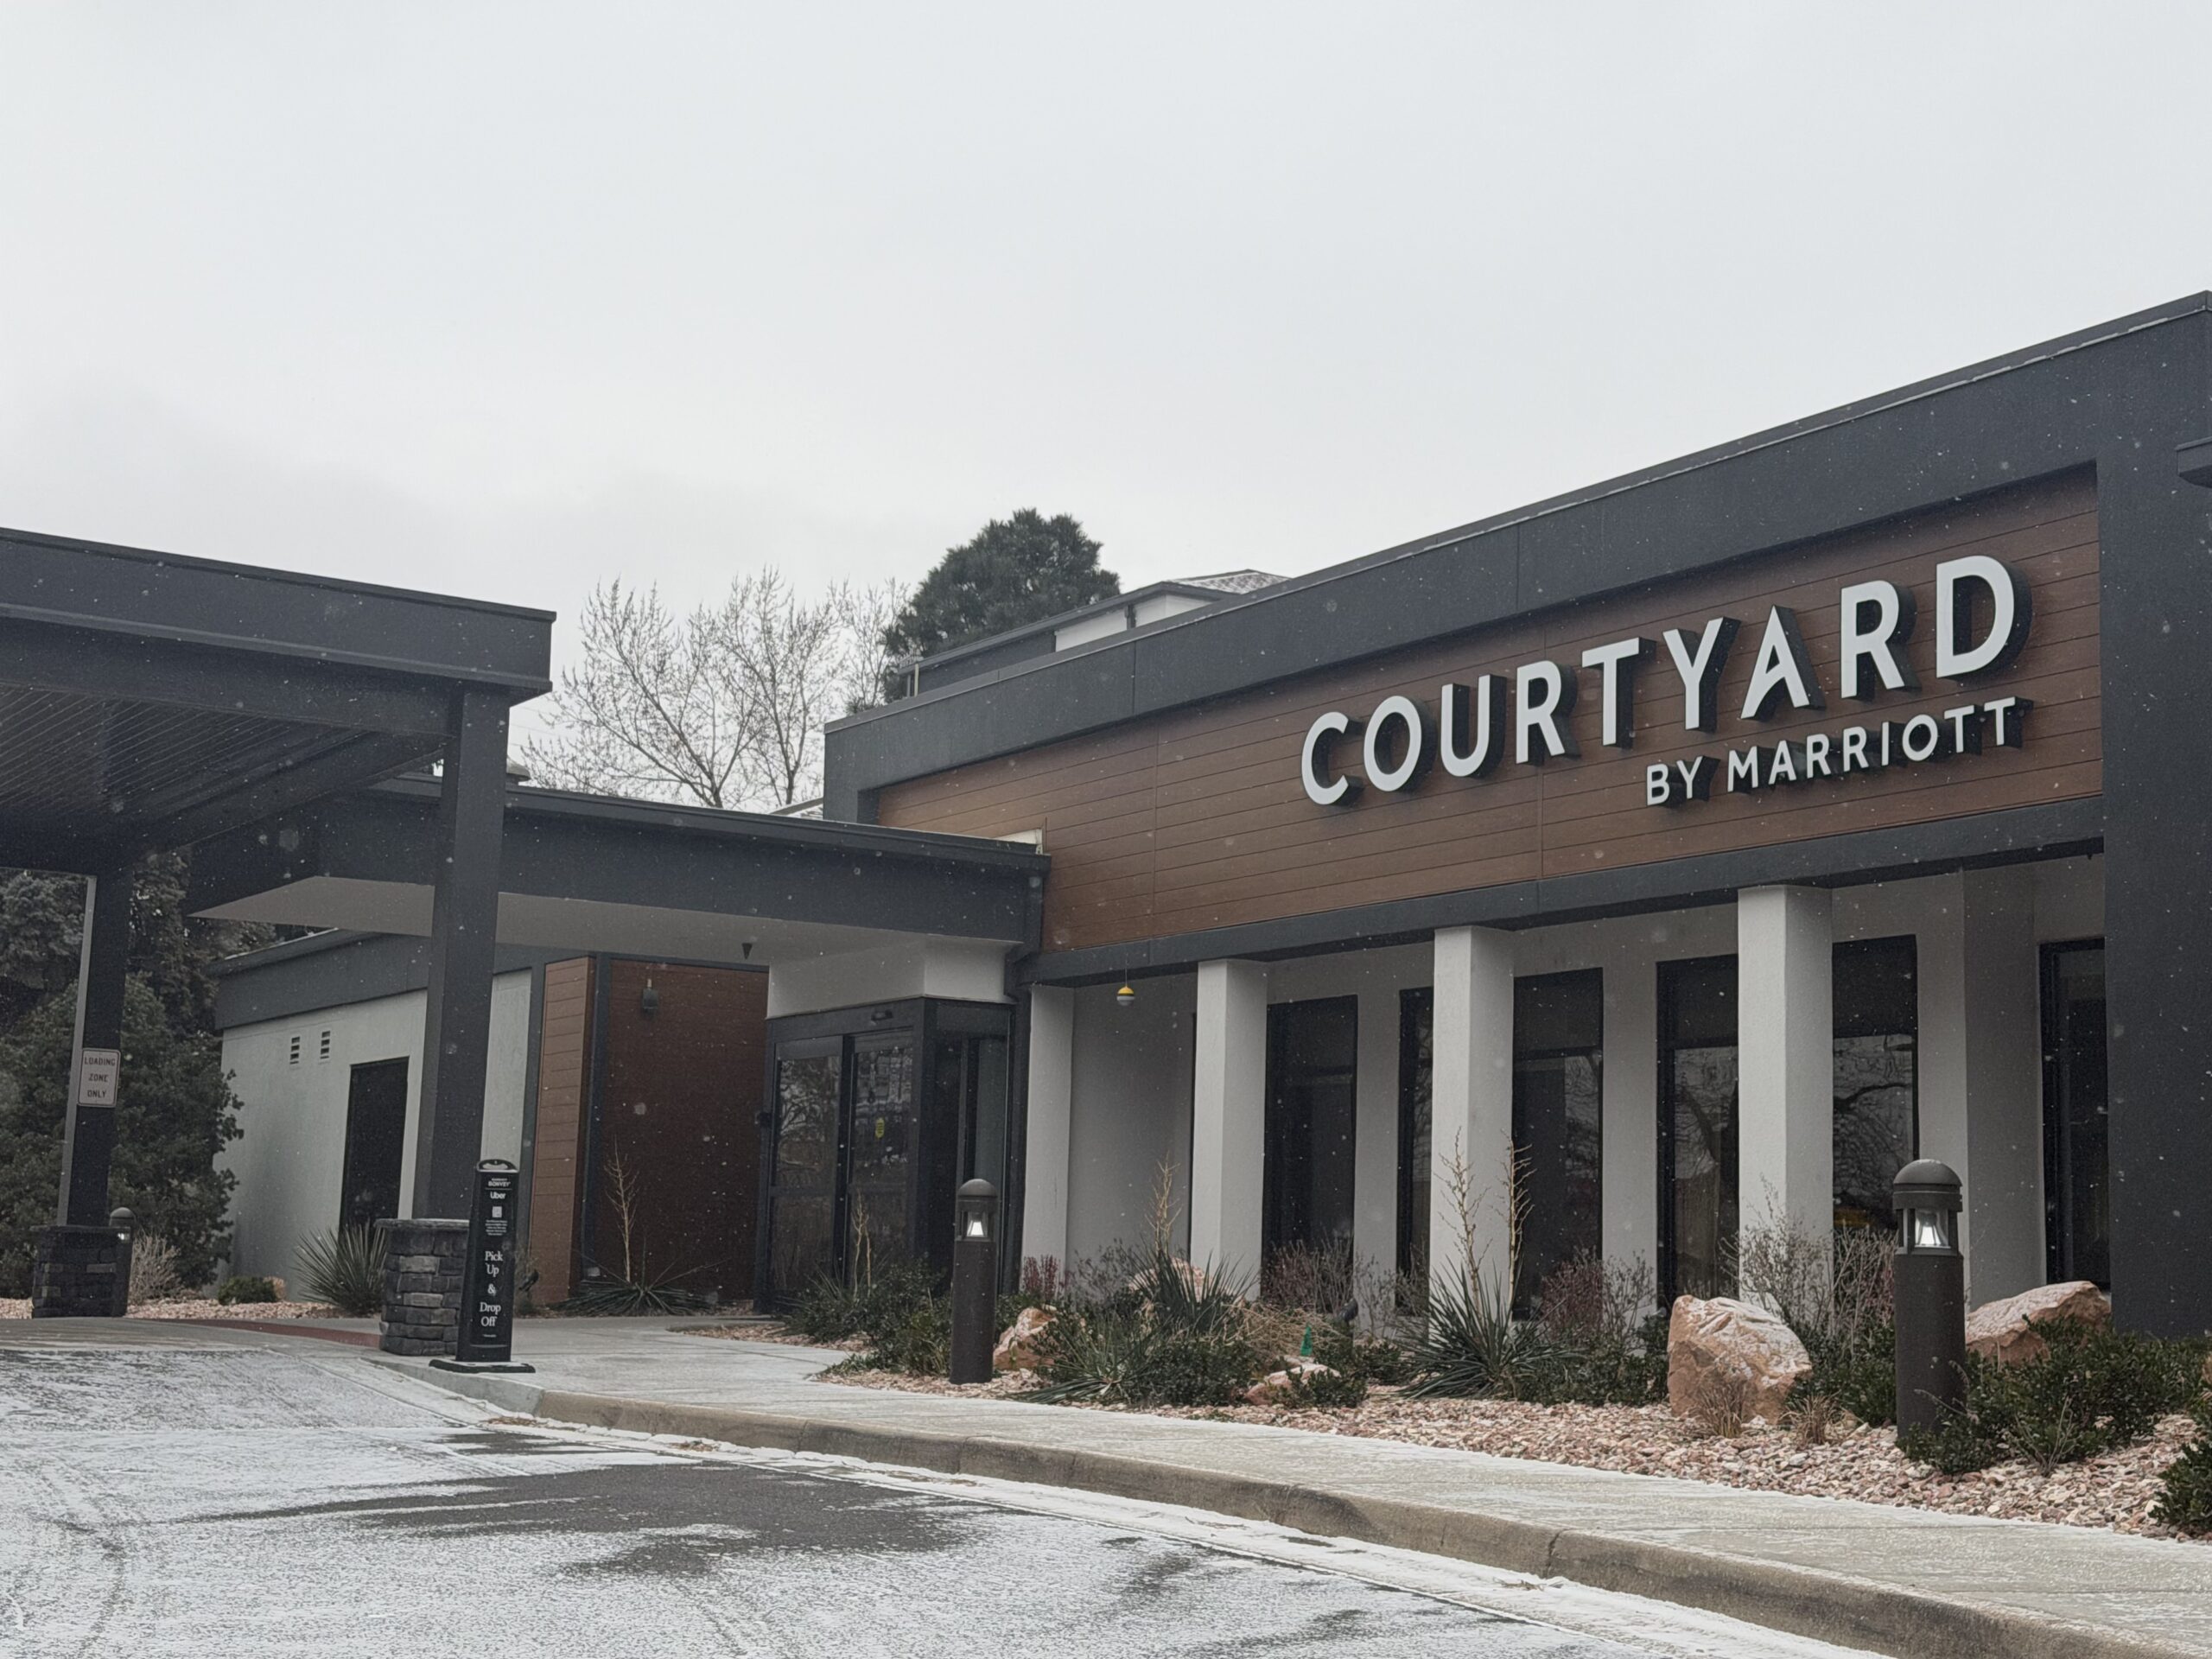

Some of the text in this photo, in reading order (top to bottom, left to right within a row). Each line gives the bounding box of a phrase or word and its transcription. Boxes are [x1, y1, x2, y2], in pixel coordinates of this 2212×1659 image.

[1300, 554, 2022, 806] COURTYARD
[1646, 696, 2020, 807] BY MARRIOTT
[84, 1057, 116, 1066] LOADING
[88, 1073, 109, 1083] ZONE
[87, 1090, 106, 1098] ONLY
[485, 1250, 504, 1262] Pick
[486, 1263, 499, 1278] Up
[487, 1283, 497, 1295] &
[480, 1301, 501, 1315] Drop
[480, 1316, 498, 1326] Off
